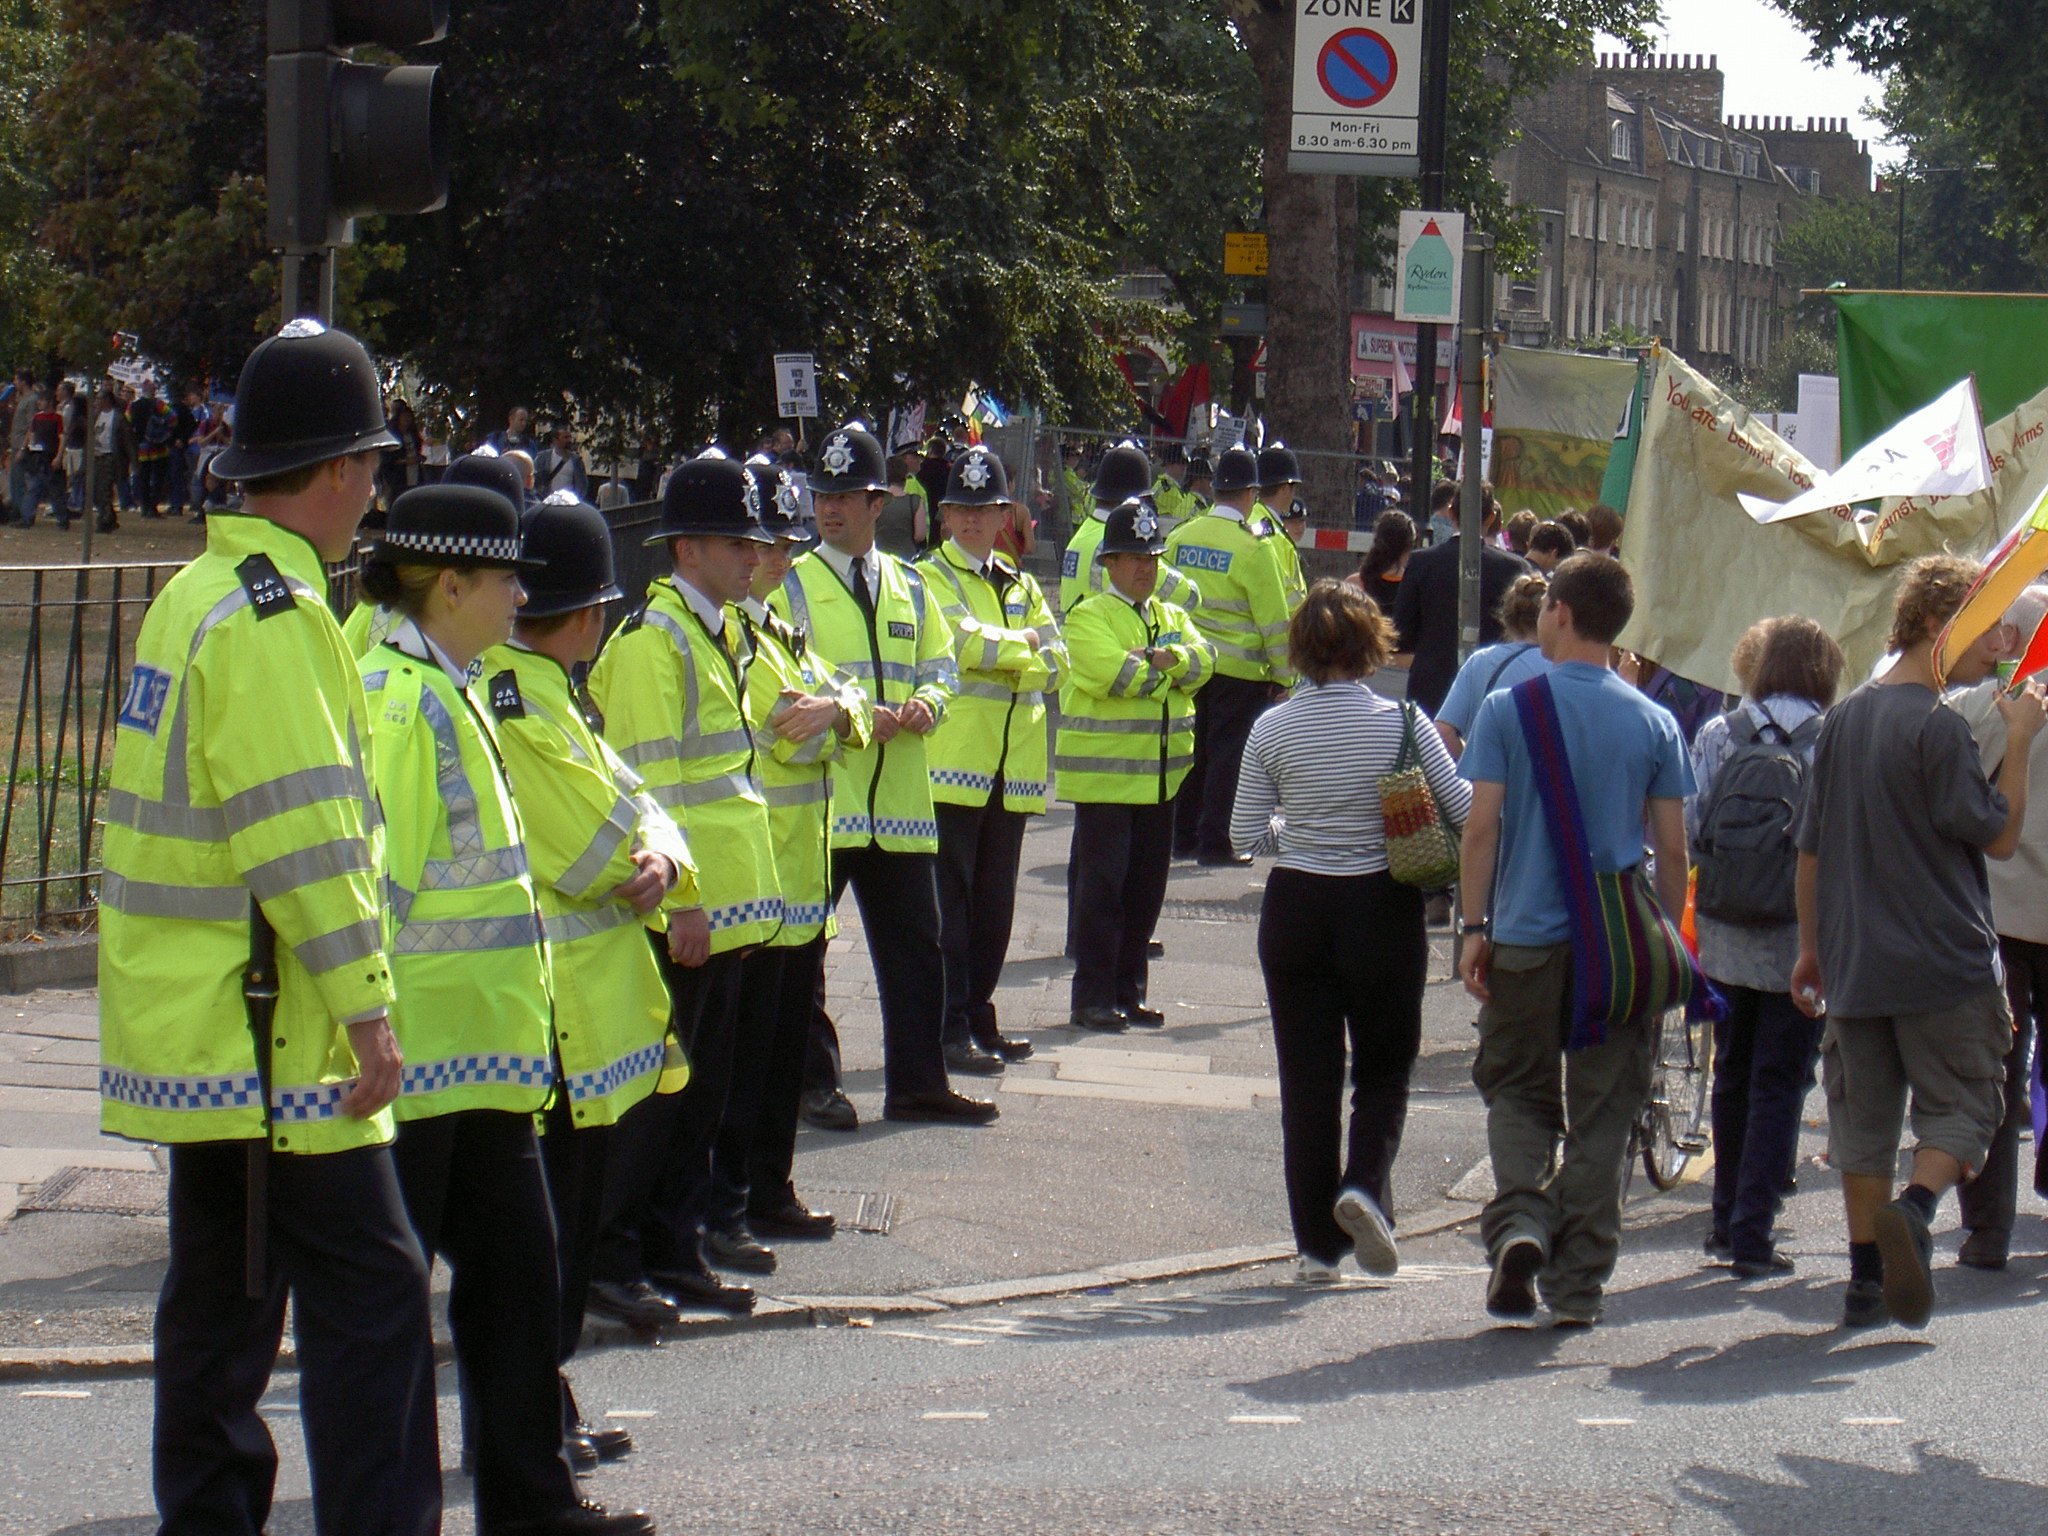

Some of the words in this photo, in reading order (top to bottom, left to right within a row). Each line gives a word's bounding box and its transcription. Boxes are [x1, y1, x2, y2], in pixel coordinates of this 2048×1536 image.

[1304, 0, 1381, 18] ZONE
[1394, 0, 1411, 20] K
[1330, 121, 1380, 134] Mon-Fri
[1298, 135, 1329, 147] 8.30
[1333, 137, 1388, 149] am-6.30
[1392, 140, 1412, 151] pm
[1407, 264, 1448, 284] Rydon
[2012, 421, 2044, 457] Arms
[1666, 375, 1691, 412] You
[1691, 404, 1719, 432] are
[1727, 421, 1776, 469] behind
[1873, 496, 1919, 543] gainst
[1178, 548, 1228, 571] POLICE
[255, 588, 285, 605] 233
